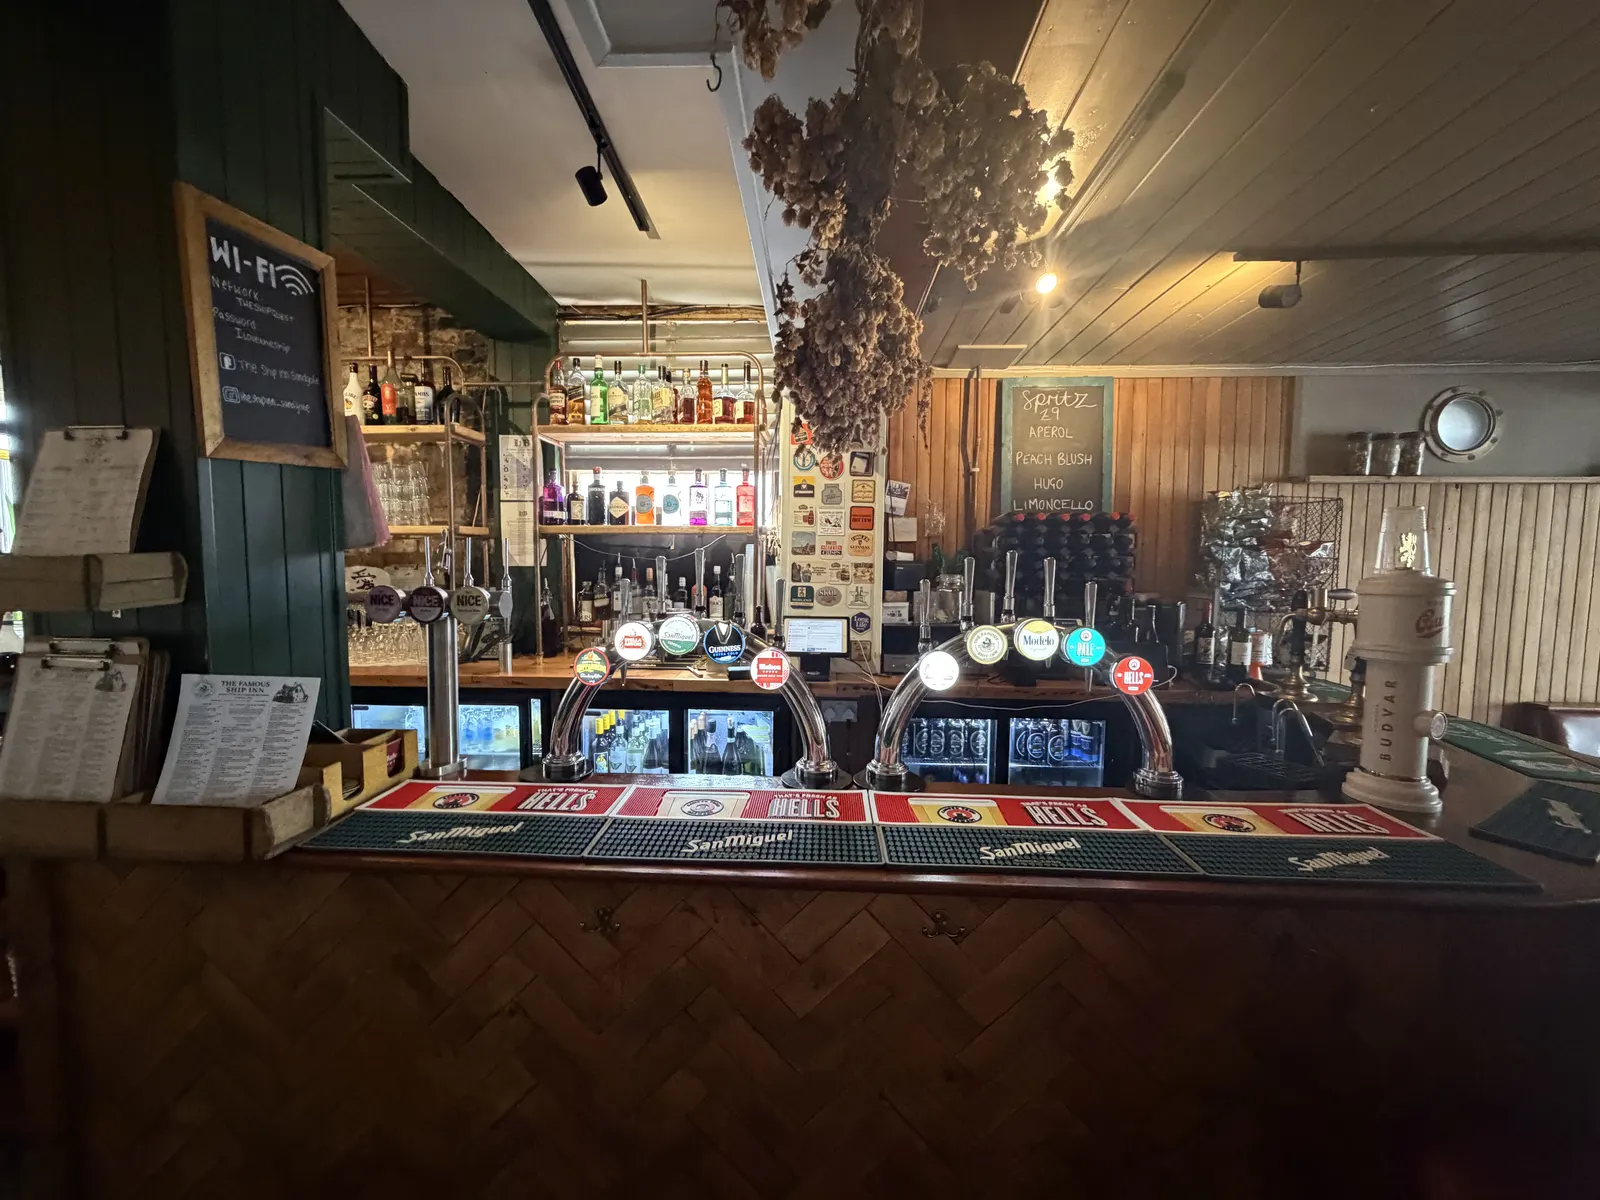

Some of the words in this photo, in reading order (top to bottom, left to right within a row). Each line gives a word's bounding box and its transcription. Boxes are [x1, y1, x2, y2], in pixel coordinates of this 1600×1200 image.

[210, 236, 276, 289] WI-FI
[1022, 390, 1097, 413] Spritz
[1029, 426, 1073, 439] APEROL
[1016, 451, 1052, 466] PEACH
[1057, 453, 1093, 466] BLUSH
[1034, 477, 1064, 490] HUGO
[369, 594, 394, 606] NICE
[412, 595, 439, 607] NICE
[456, 594, 482, 606] NICE
[1023, 635, 1055, 646] Modelo
[708, 644, 742, 654] GUINNESS
[1076, 642, 1095, 657] PALE
[1123, 671, 1144, 685] HELLS
[1379, 680, 1398, 762] BUDVAR
[516, 792, 597, 811] HELLS
[771, 799, 840, 818] HELLS
[1025, 806, 1108, 826] HELLS
[1285, 812, 1390, 834] HELLS
